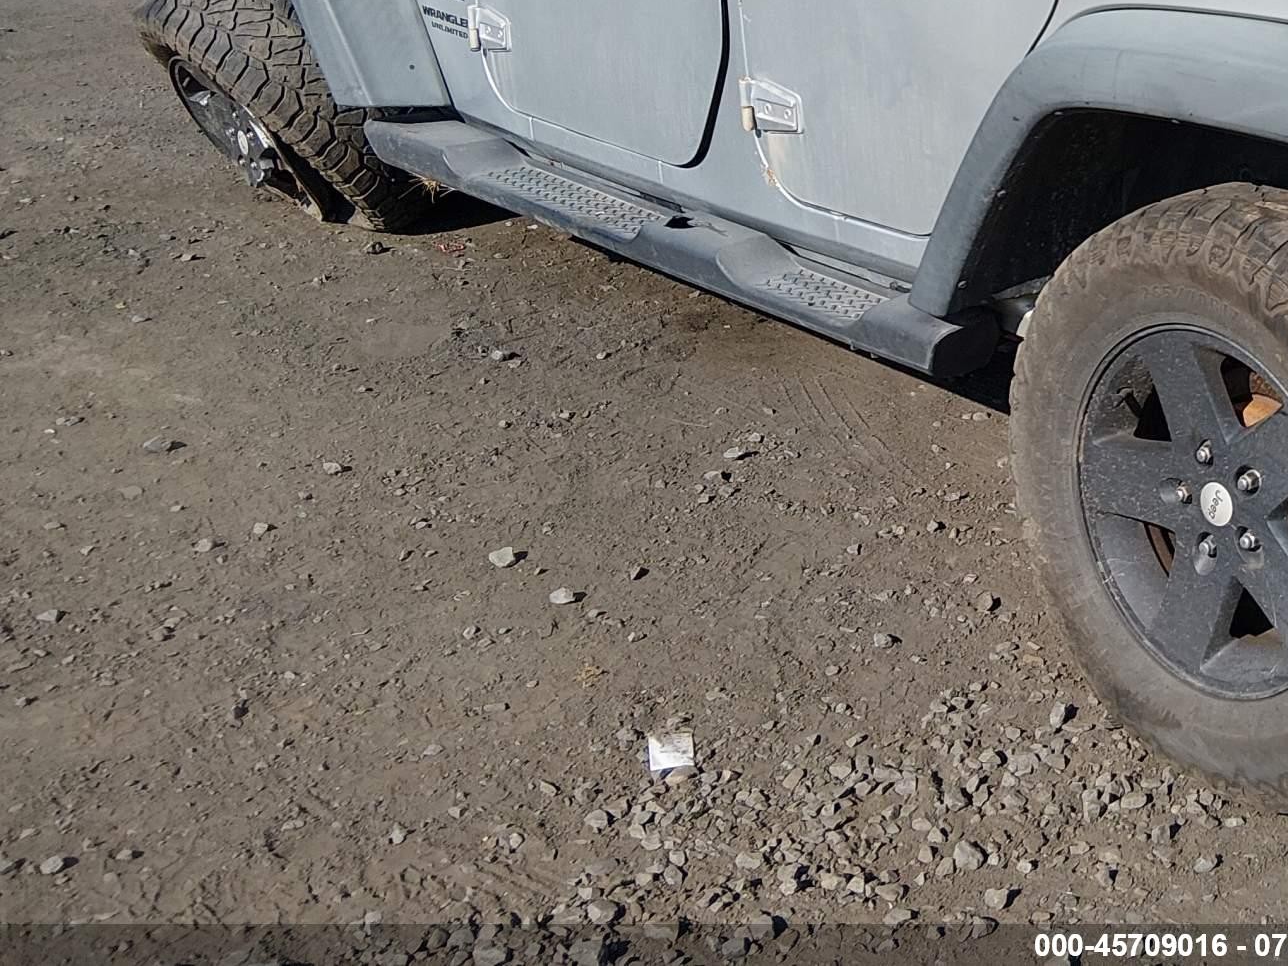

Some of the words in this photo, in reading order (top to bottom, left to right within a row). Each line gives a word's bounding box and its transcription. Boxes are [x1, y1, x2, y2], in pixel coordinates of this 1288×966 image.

[422, 5, 469, 29] WRANGLE
[431, 21, 469, 40] UNLIMITED
[1207, 489, 1224, 520] Jeep
